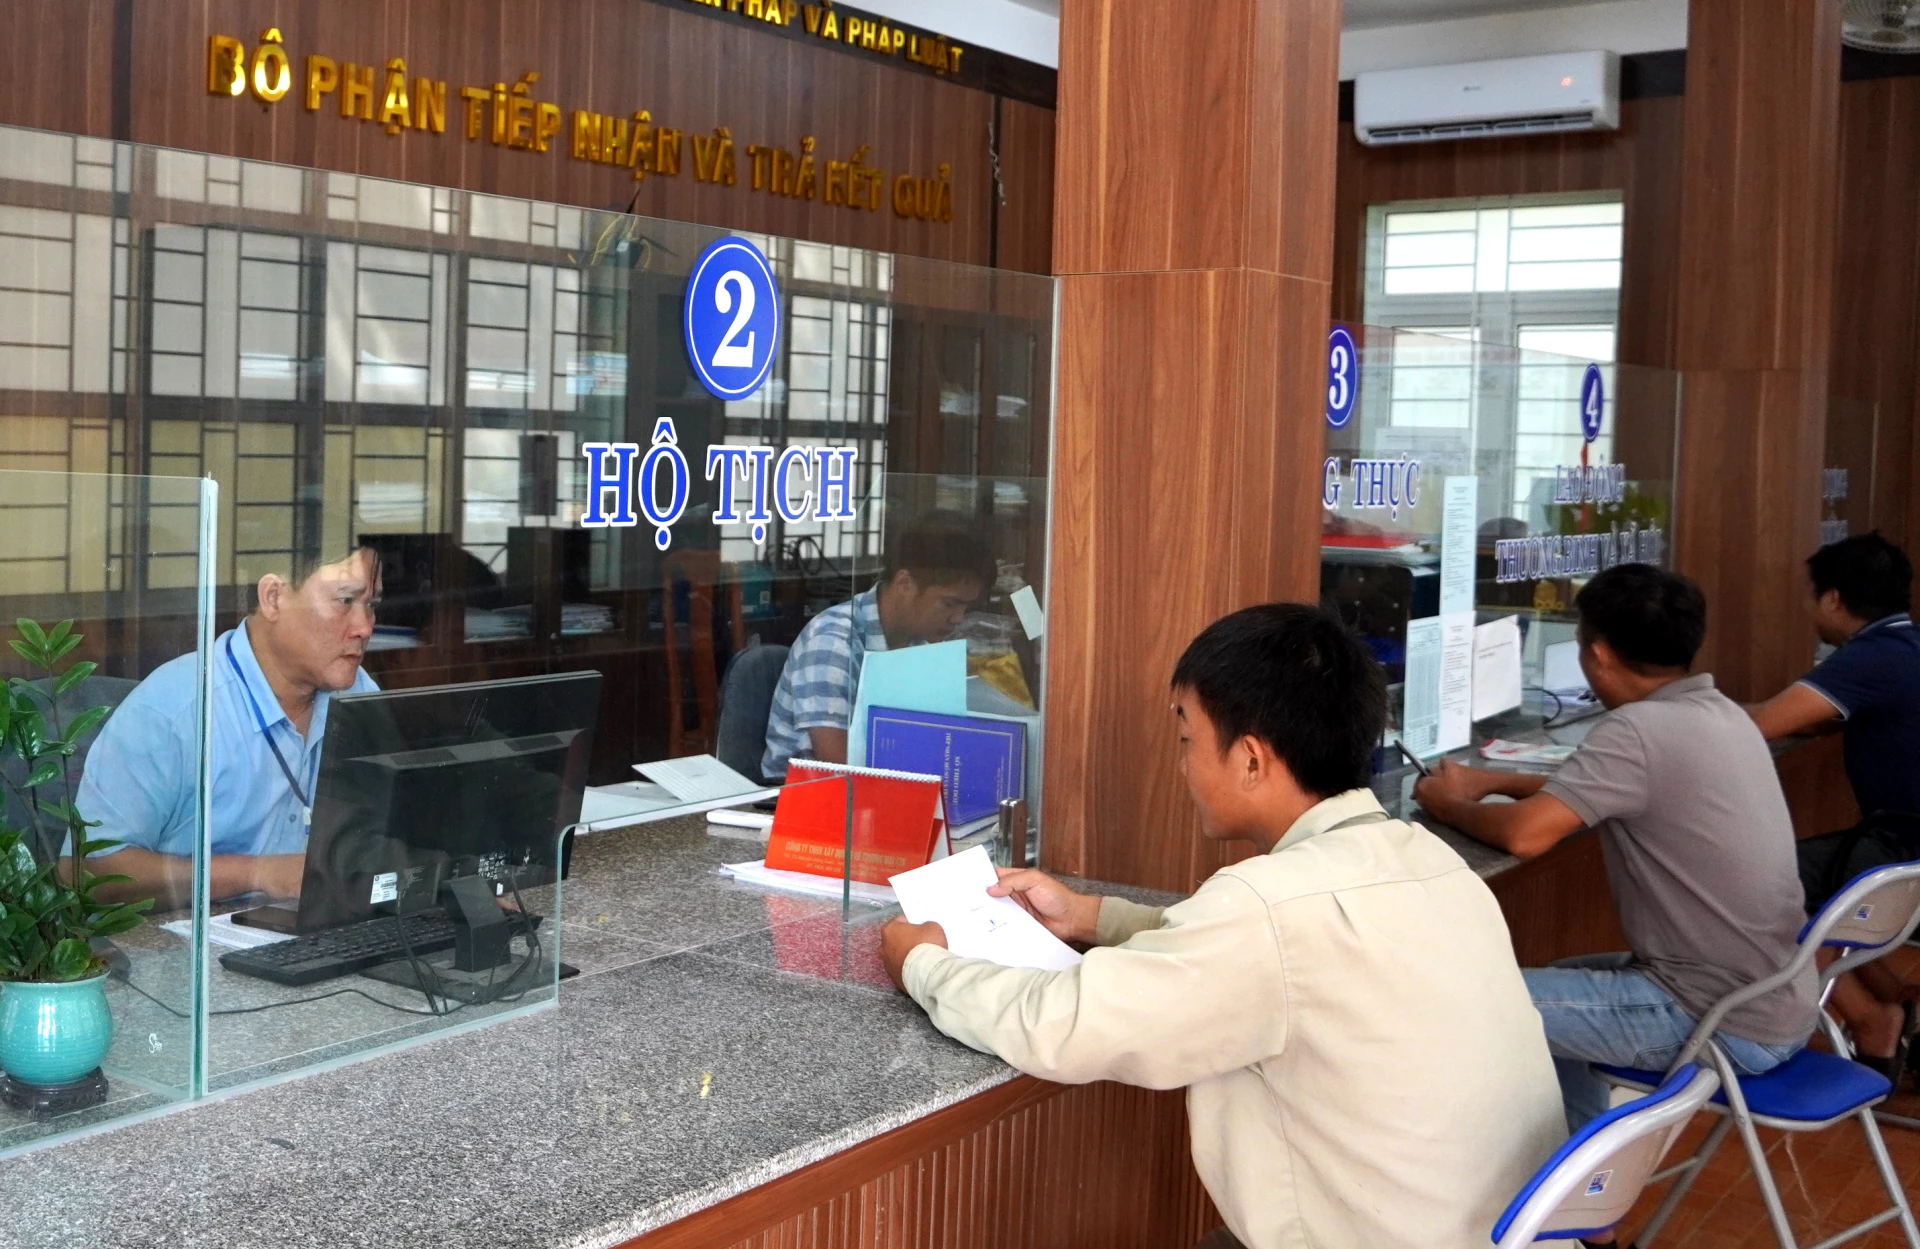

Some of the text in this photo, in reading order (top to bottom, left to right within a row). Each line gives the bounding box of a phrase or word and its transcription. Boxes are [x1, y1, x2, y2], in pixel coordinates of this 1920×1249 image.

[803, 0, 838, 39] VÀ
[846, 16, 905, 55] PHÁP
[908, 33, 962, 75] LUẬT
[305, 57, 447, 136] PHẬN
[572, 110, 683, 180] NHẬN
[691, 127, 736, 186] VÀ
[747, 136, 817, 200] TRẢ
[825, 144, 885, 211] KẾT
[892, 162, 953, 222] QUẢ
[711, 269, 756, 368] 2
[1328, 345, 1348, 410] 3
[1585, 378, 1599, 428] 4
[581, 416, 858, 550] HỘ TỊCH
[1350, 452, 1421, 521] THỰC
